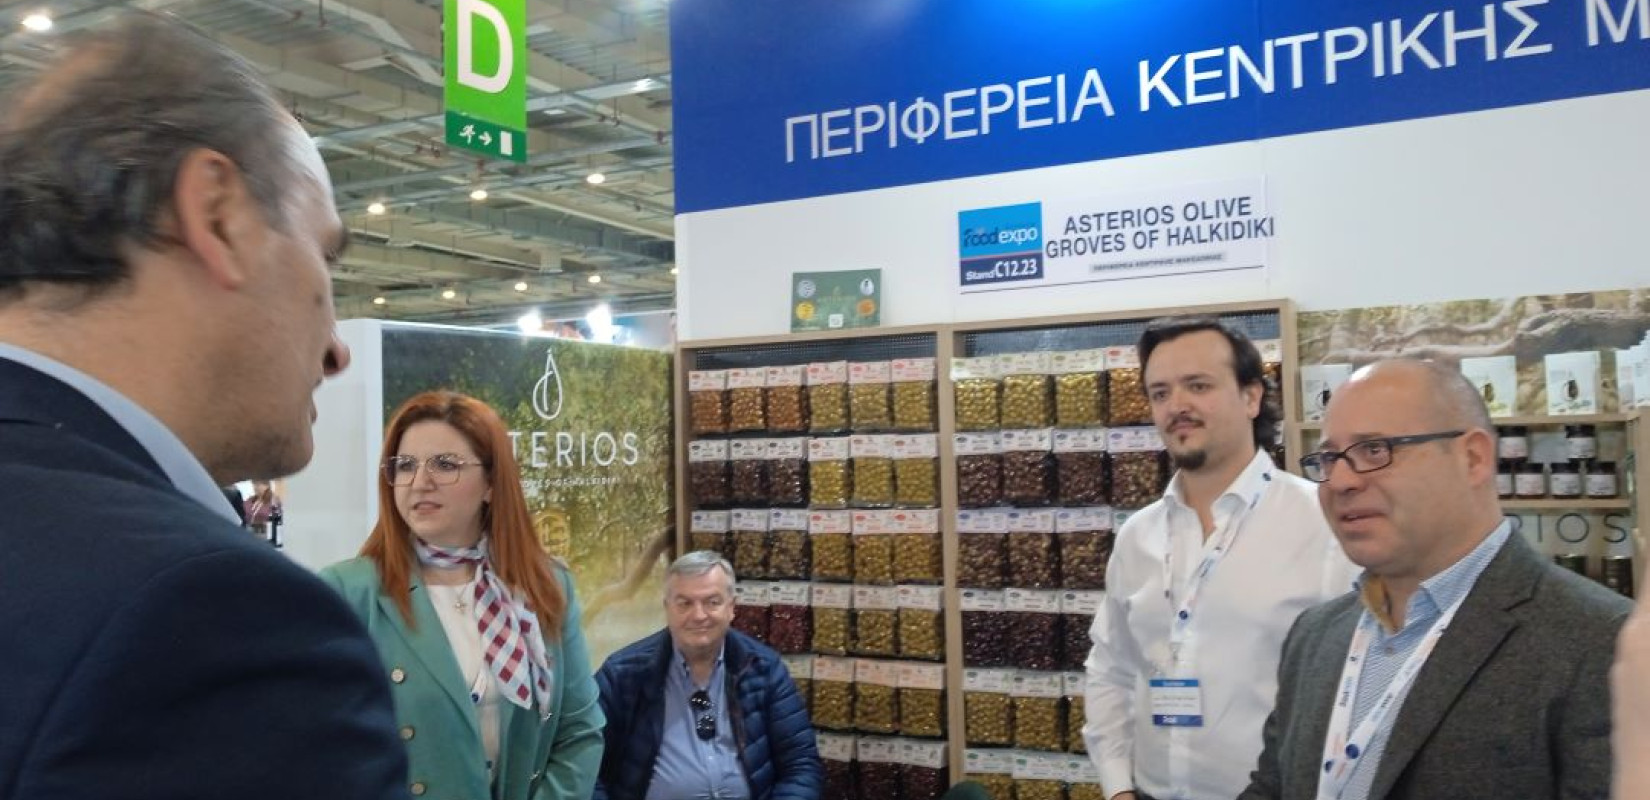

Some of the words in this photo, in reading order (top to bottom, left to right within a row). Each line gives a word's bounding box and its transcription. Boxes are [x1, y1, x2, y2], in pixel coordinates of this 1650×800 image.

[457, 0, 513, 93] D
[785, 67, 1115, 163] ΠΕΡΙΦΕΡΕΙΑ
[1137, 0, 1553, 112] ΚΕΝΤΡΙΚΗΣ
[1046, 234, 1126, 259] GROVES
[1132, 226, 1160, 250] OF
[1166, 217, 1275, 247] HALKIDIKI
[1064, 206, 1174, 236] ASTERIOS
[1182, 196, 1252, 224] OLIVE
